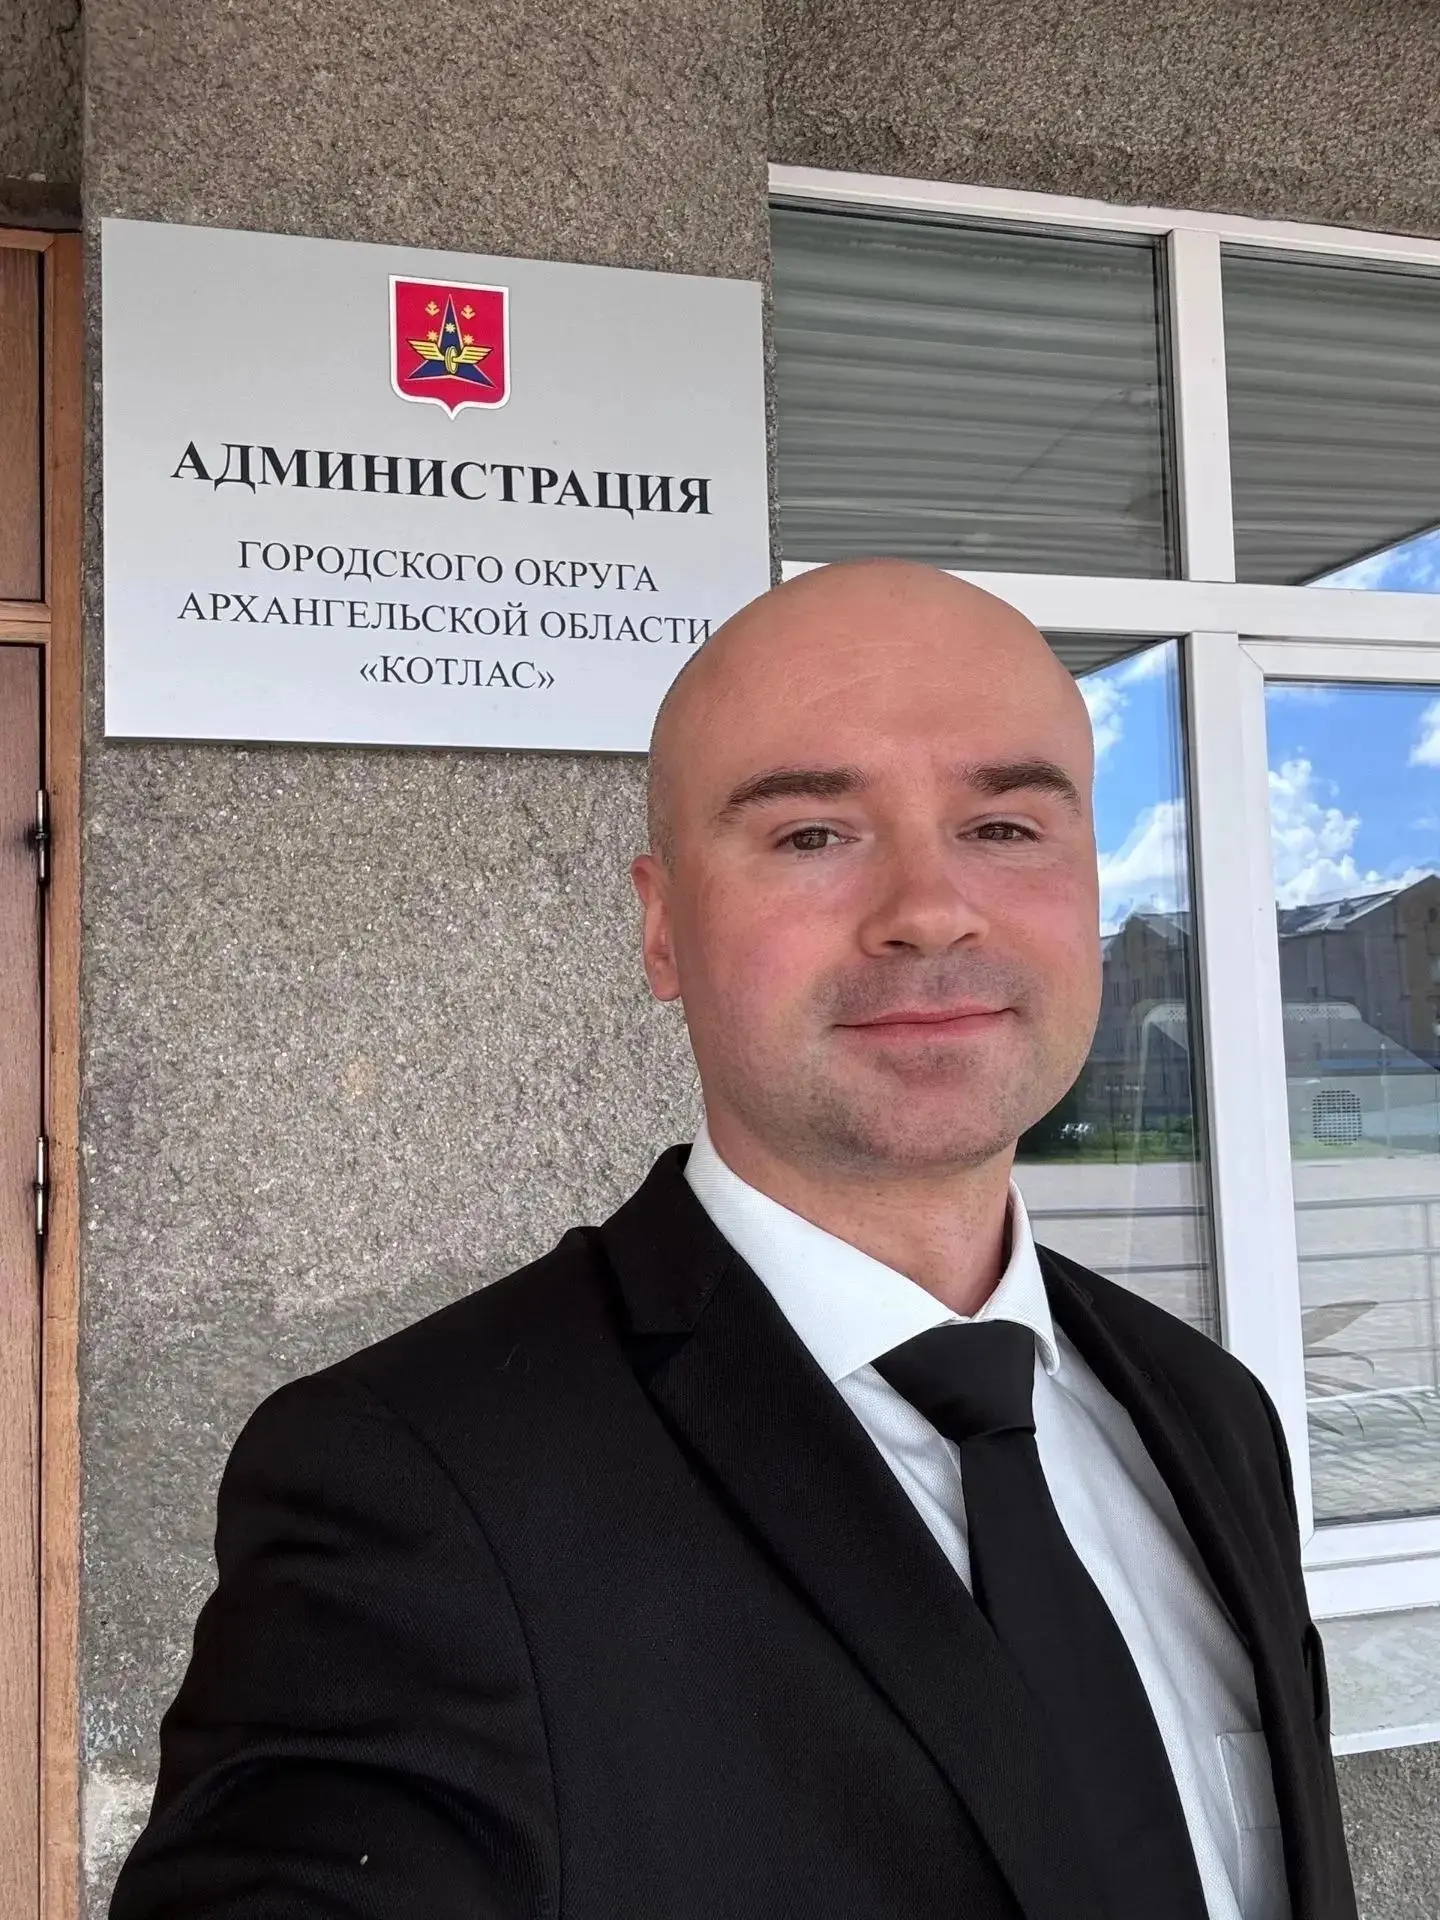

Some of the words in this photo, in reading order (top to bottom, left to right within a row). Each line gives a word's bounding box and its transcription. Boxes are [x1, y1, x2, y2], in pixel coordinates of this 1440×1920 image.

[171, 441, 713, 520] АДМИНИСТРАЦИЯ
[239, 540, 503, 582] ГОРОДСКОГО
[515, 558, 660, 593] ОКРУГА
[177, 592, 529, 637] АРХАНГЕЛЬСКОЙ
[540, 611, 712, 644] ОБЛАСТИ
[359, 655, 556, 690] «КОТЛАС»
